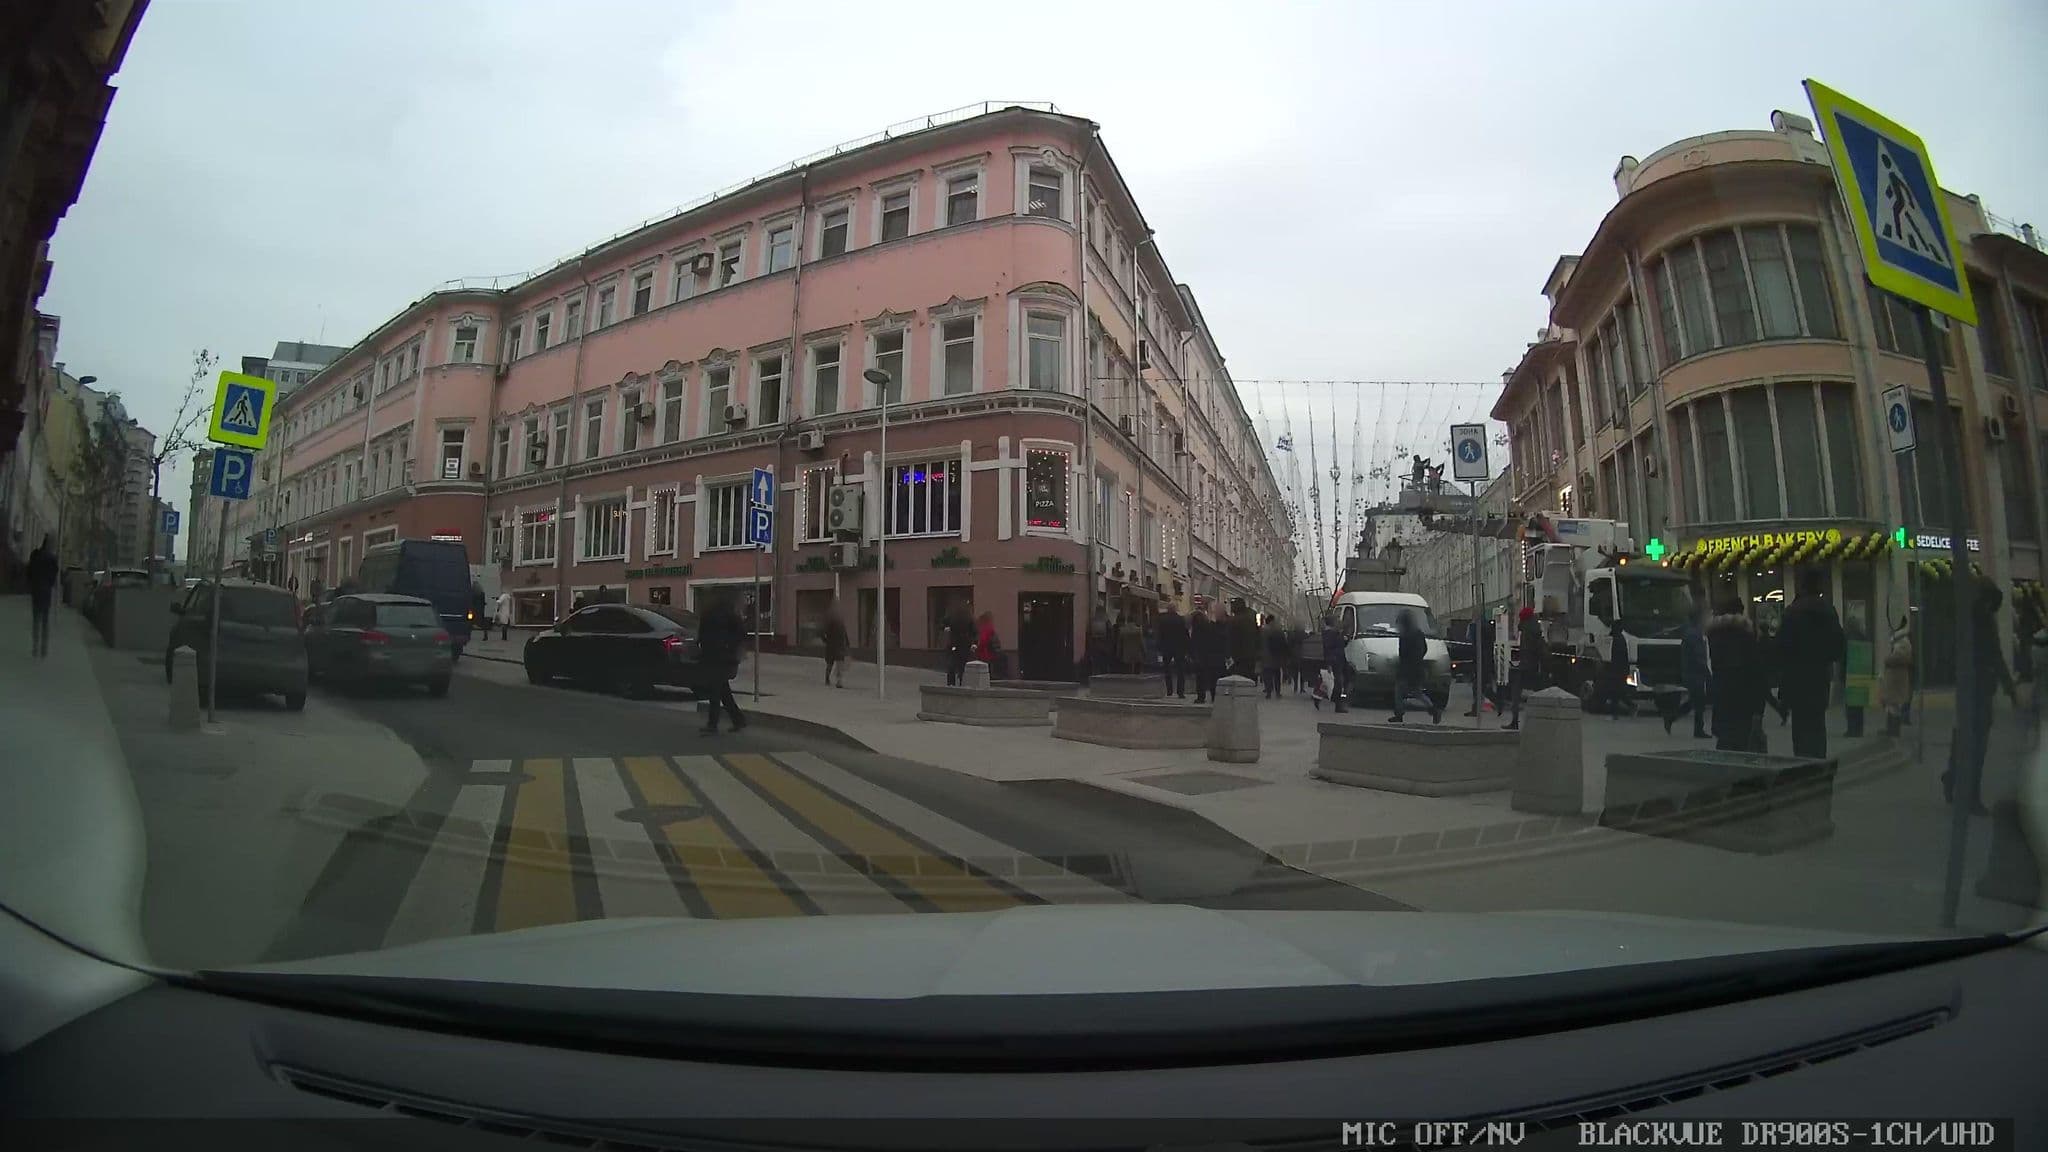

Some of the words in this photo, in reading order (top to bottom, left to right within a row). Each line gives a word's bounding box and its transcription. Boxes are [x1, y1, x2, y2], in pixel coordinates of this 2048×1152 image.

[1035, 500, 1055, 508] PIZZA
[1708, 534, 1759, 553] FRENCH
[1764, 530, 1825, 547] BAKERY
[1916, 535, 1952, 549] SEDELICE
